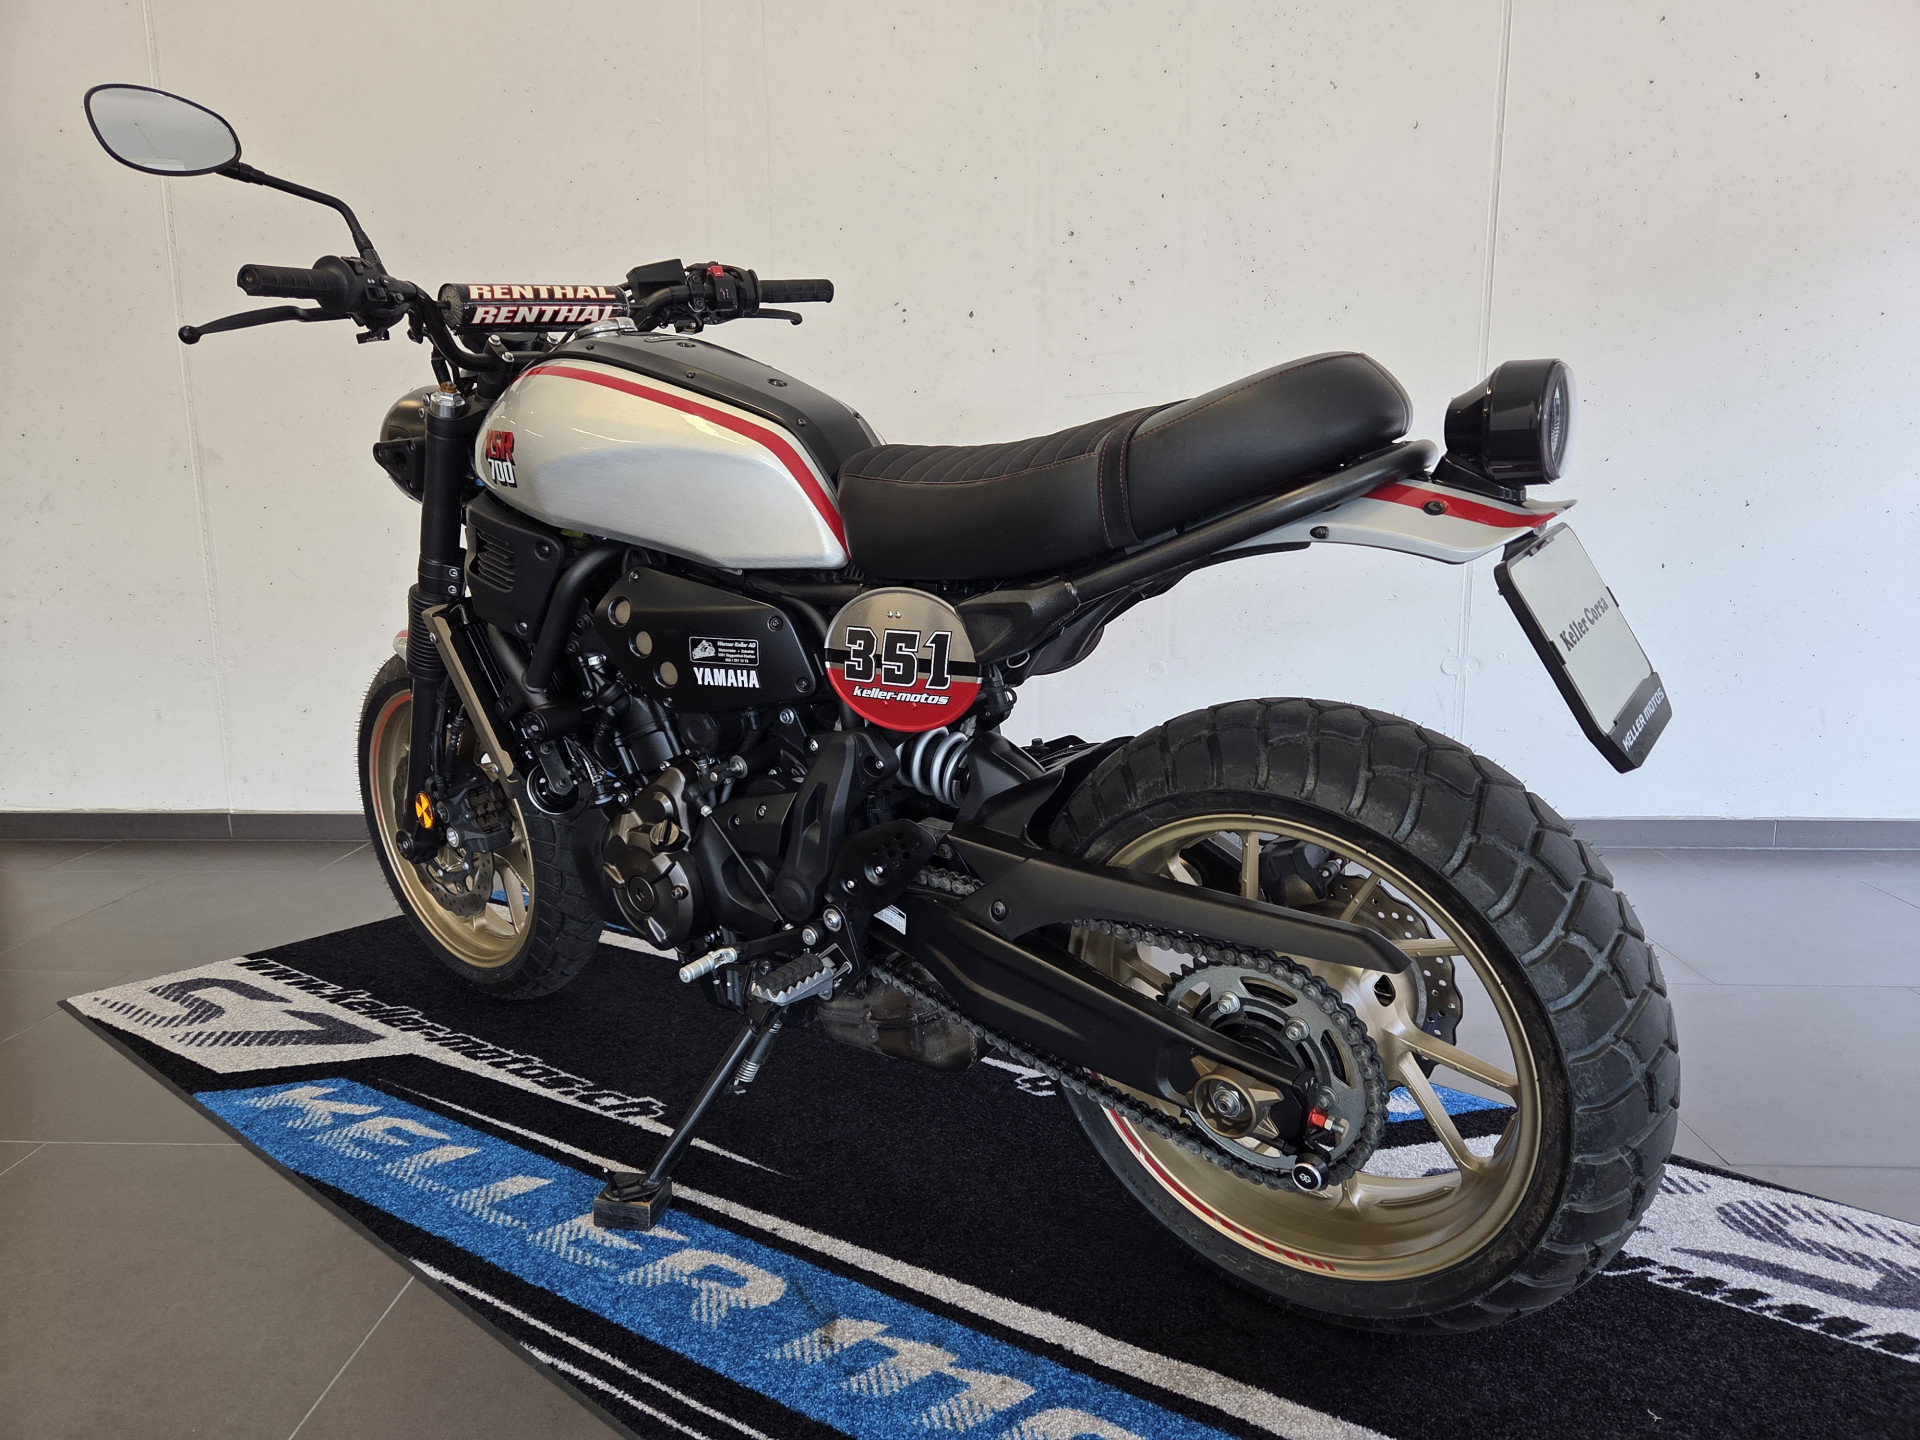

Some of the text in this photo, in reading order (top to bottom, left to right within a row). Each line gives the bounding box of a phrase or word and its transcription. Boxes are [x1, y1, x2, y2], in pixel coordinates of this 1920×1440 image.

[468, 285, 617, 300] RENTHAL
[471, 304, 619, 325] RENTHAL
[487, 458, 517, 488] 700
[1559, 597, 1609, 652] Keller Corsa
[693, 667, 760, 688] YAMAHA
[844, 626, 952, 691] 351
[853, 685, 951, 706] keller-motos
[1622, 686, 1665, 752] KELLER MOTOS
[234, 957, 667, 1119] www.keller-motos.ch
[234, 1085, 787, 1328] KELLER
